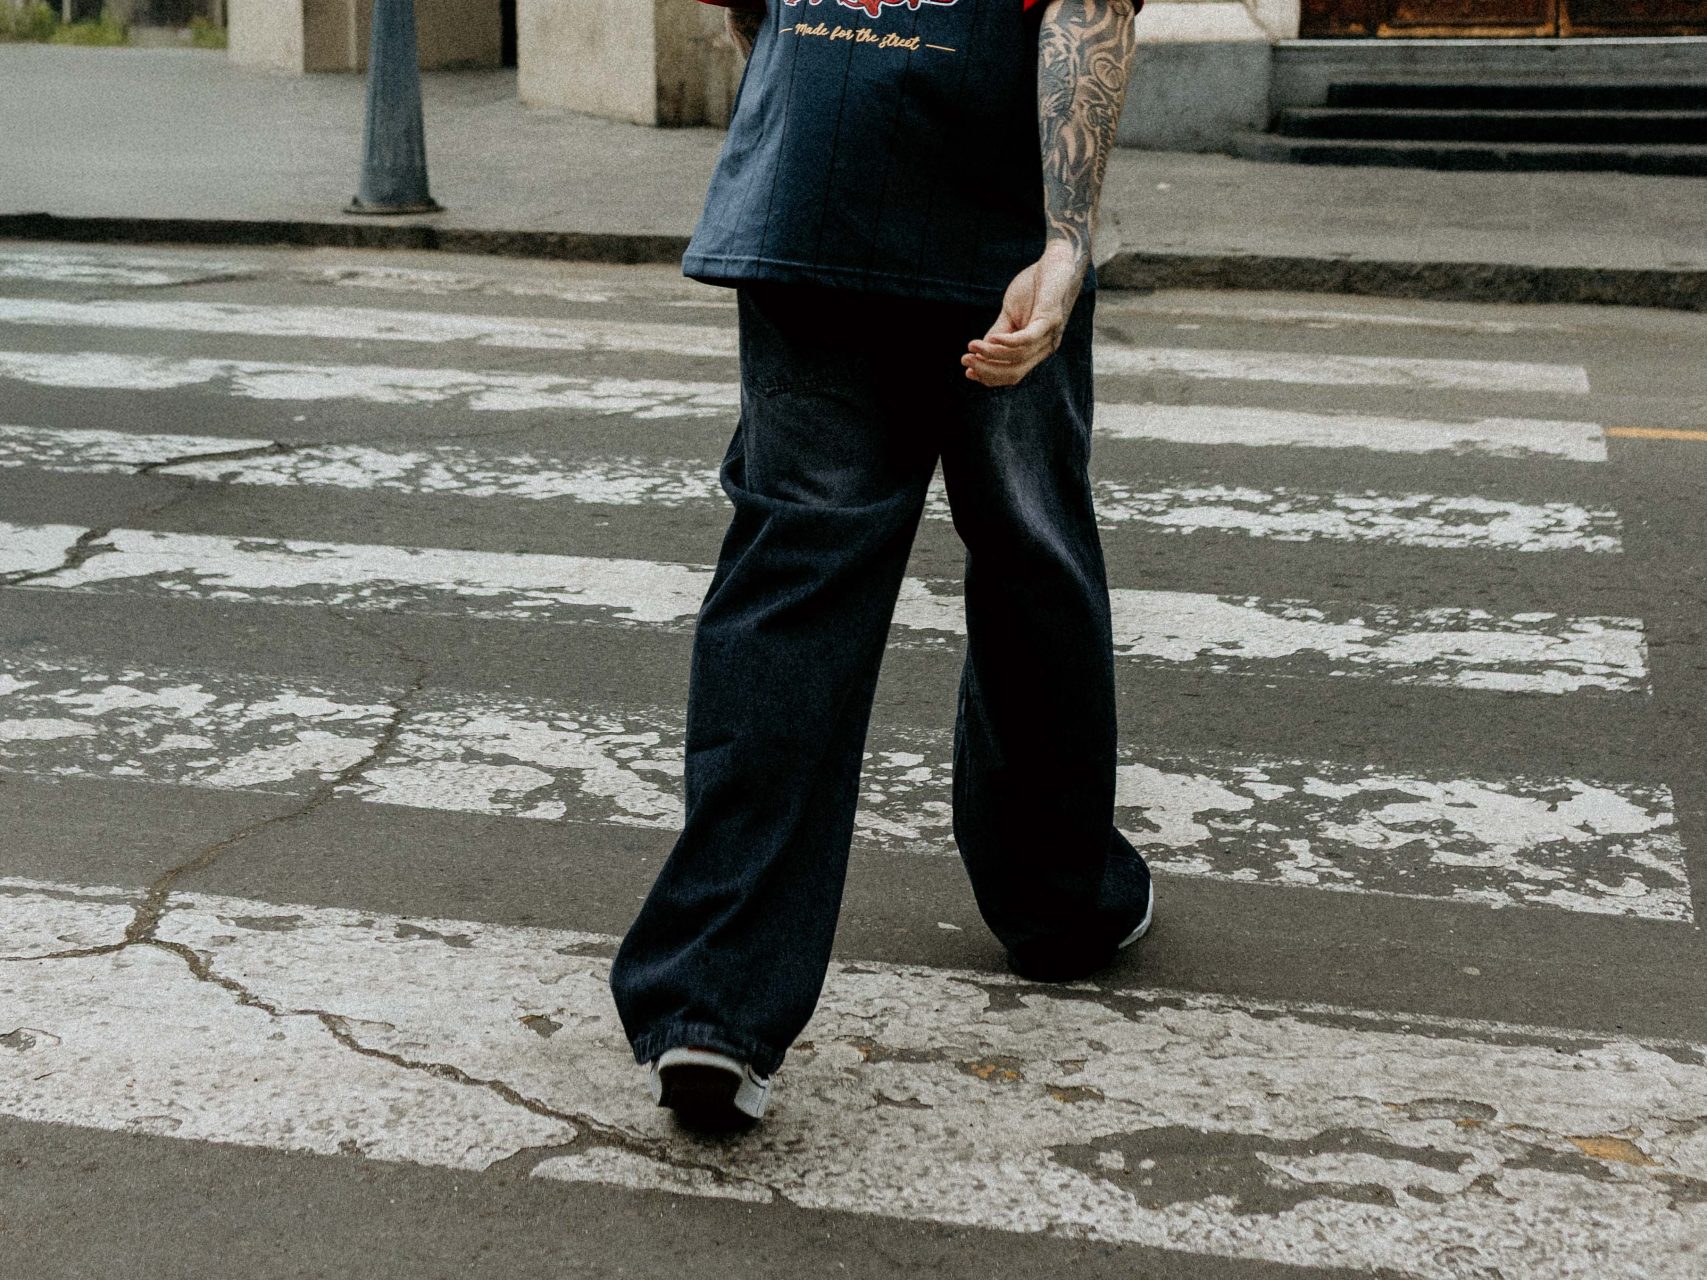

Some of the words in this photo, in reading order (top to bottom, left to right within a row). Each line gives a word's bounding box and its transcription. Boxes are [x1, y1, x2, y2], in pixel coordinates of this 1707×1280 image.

[795, 22, 830, 36] Made
[830, 25, 854, 40] for
[855, 28, 879, 42] the
[878, 32, 920, 50] street
